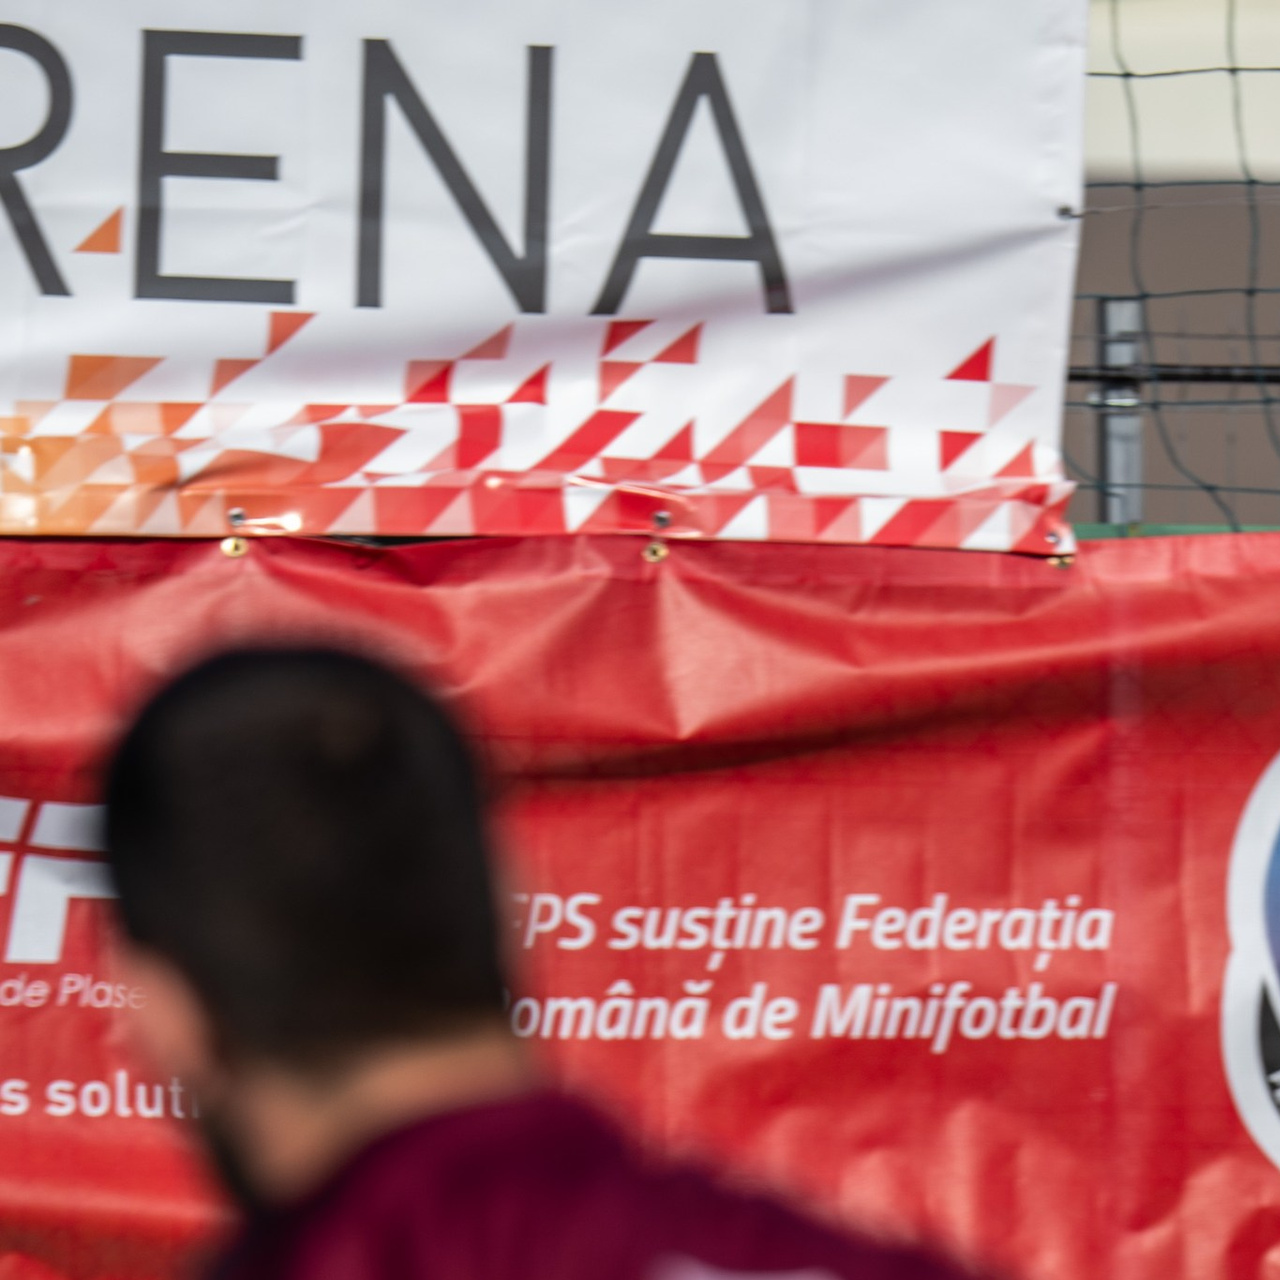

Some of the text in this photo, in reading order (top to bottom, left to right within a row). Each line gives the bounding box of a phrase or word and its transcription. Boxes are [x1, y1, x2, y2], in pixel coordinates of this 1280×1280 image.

[835, 892, 1116, 972] Federația
[503, 979, 1119, 1055] omână de Minifotbal
